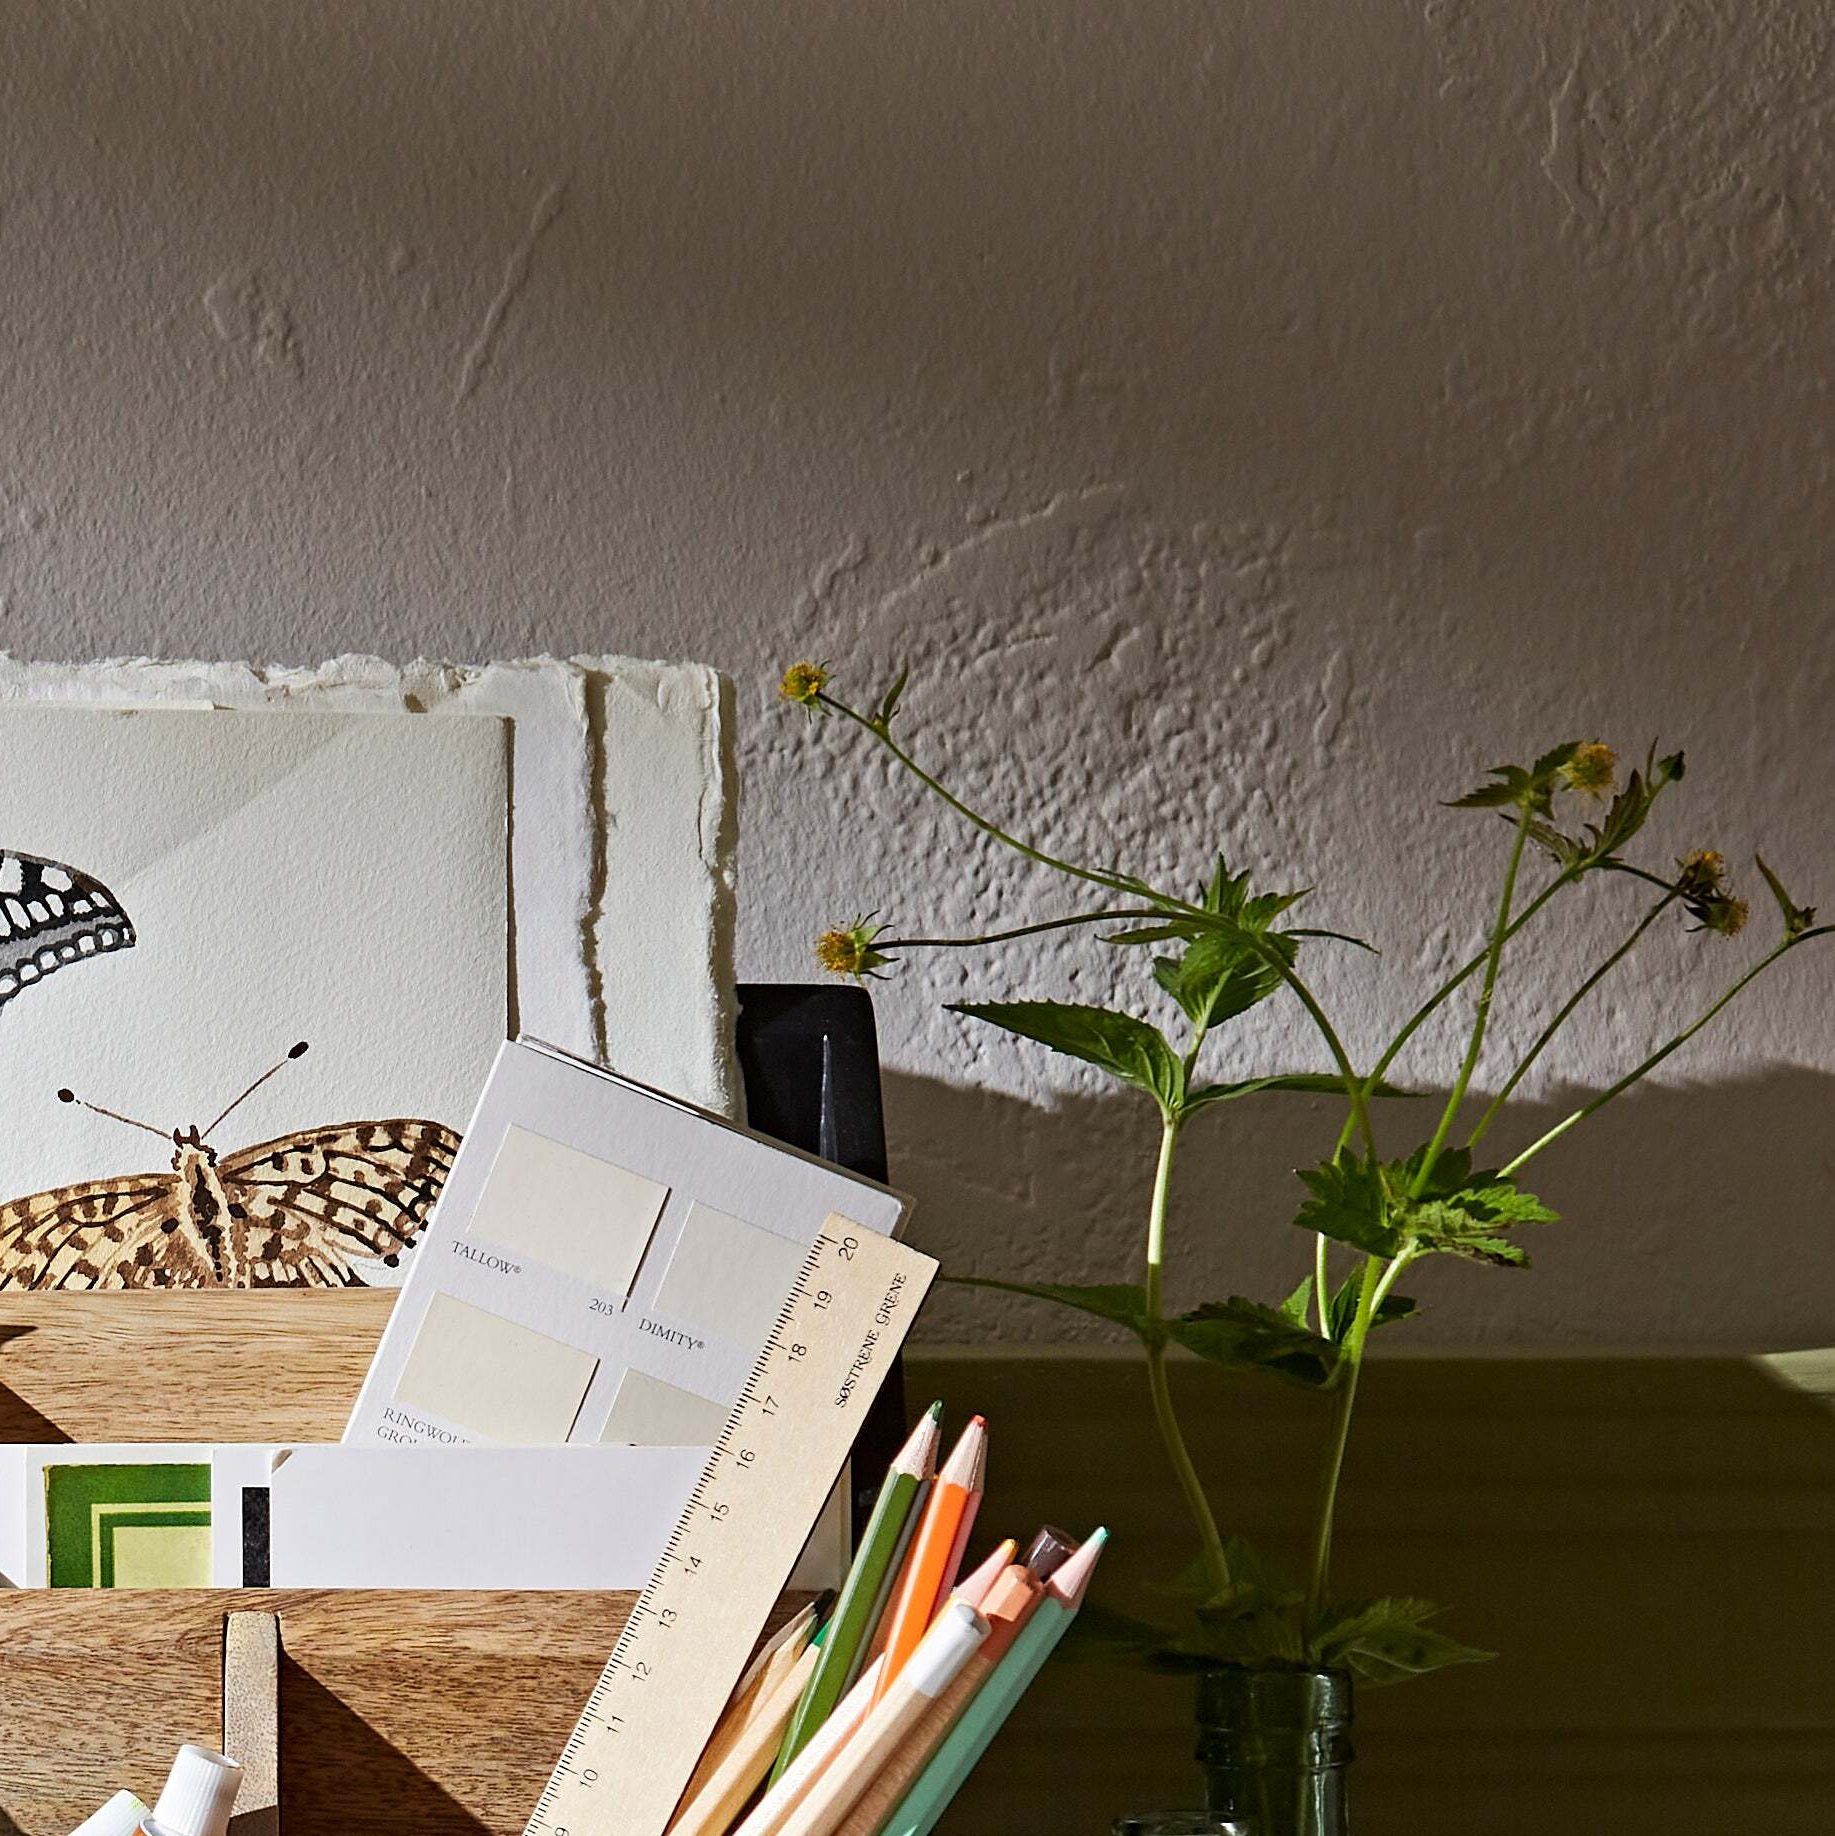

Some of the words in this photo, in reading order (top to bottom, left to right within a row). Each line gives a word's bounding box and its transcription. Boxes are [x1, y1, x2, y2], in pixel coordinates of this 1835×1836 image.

[588, 1298, 614, 1316] 203
[834, 1329, 880, 1408] SØSTRENE
[875, 1272, 907, 1326] GRENE
[580, 1768, 599, 1788] 10
[606, 1715, 625, 1734] 11
[632, 1661, 651, 1682] 12
[659, 1608, 677, 1628] 13
[684, 1556, 701, 1576] 14
[710, 1503, 730, 1522] 15
[736, 1449, 756, 1469] 16
[762, 1395, 779, 1415] 17
[788, 1343, 807, 1363] 18
[814, 1290, 832, 1310] 19
[838, 1237, 859, 1261] 20
